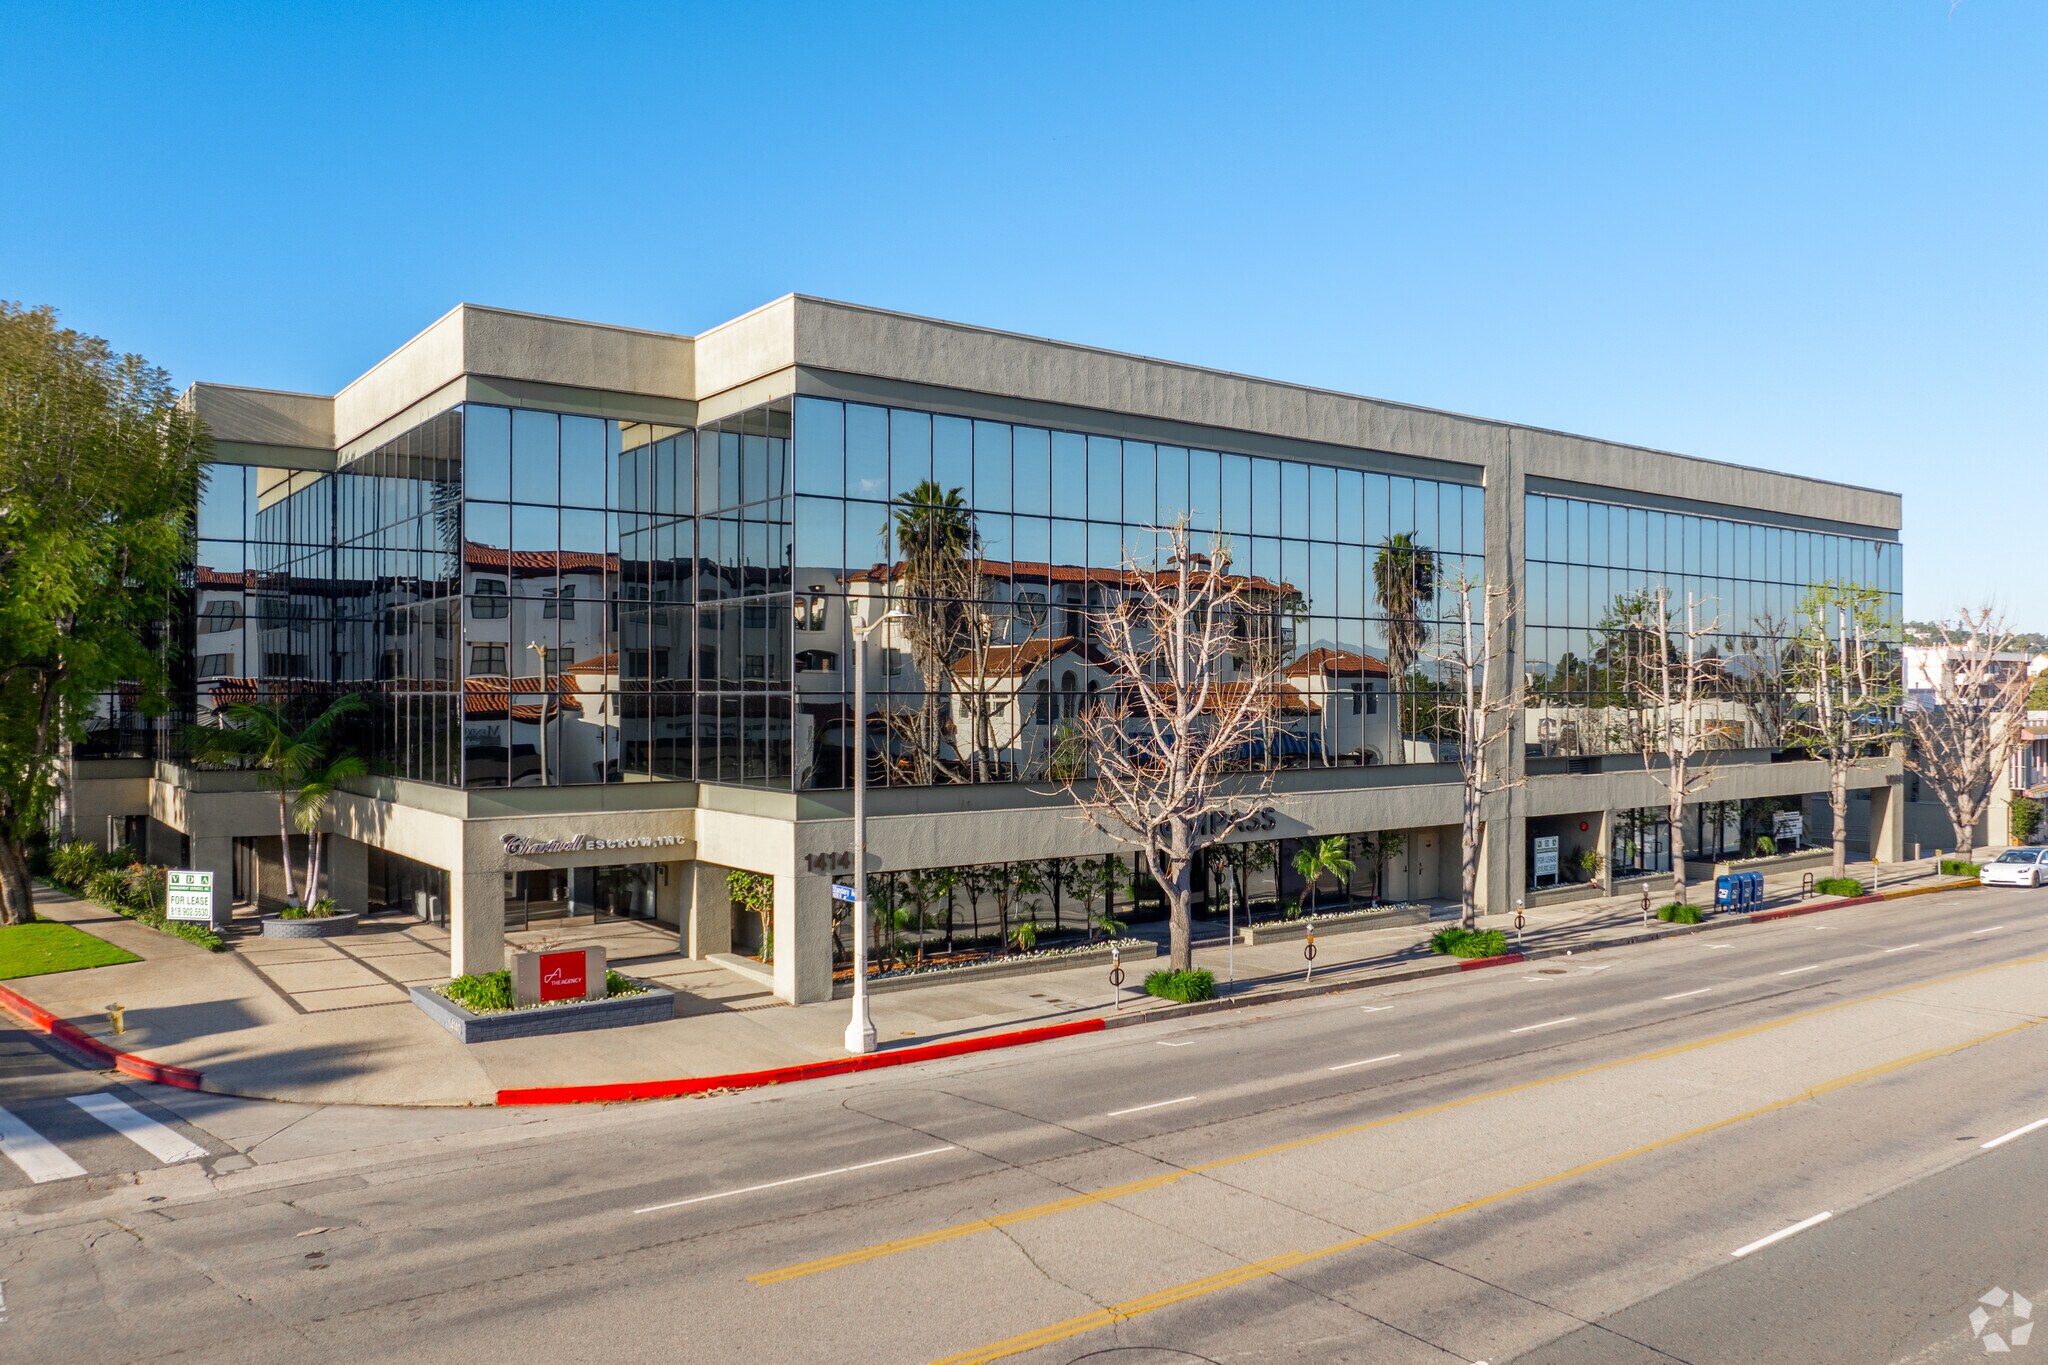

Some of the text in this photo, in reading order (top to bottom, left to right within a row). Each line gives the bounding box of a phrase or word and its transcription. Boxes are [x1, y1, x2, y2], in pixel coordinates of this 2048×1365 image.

[1146, 807, 1276, 838] MPASS
[500, 833, 585, 855] Chartwell
[805, 851, 855, 872] 1414
[171, 896, 208, 905] FOR LEASE
